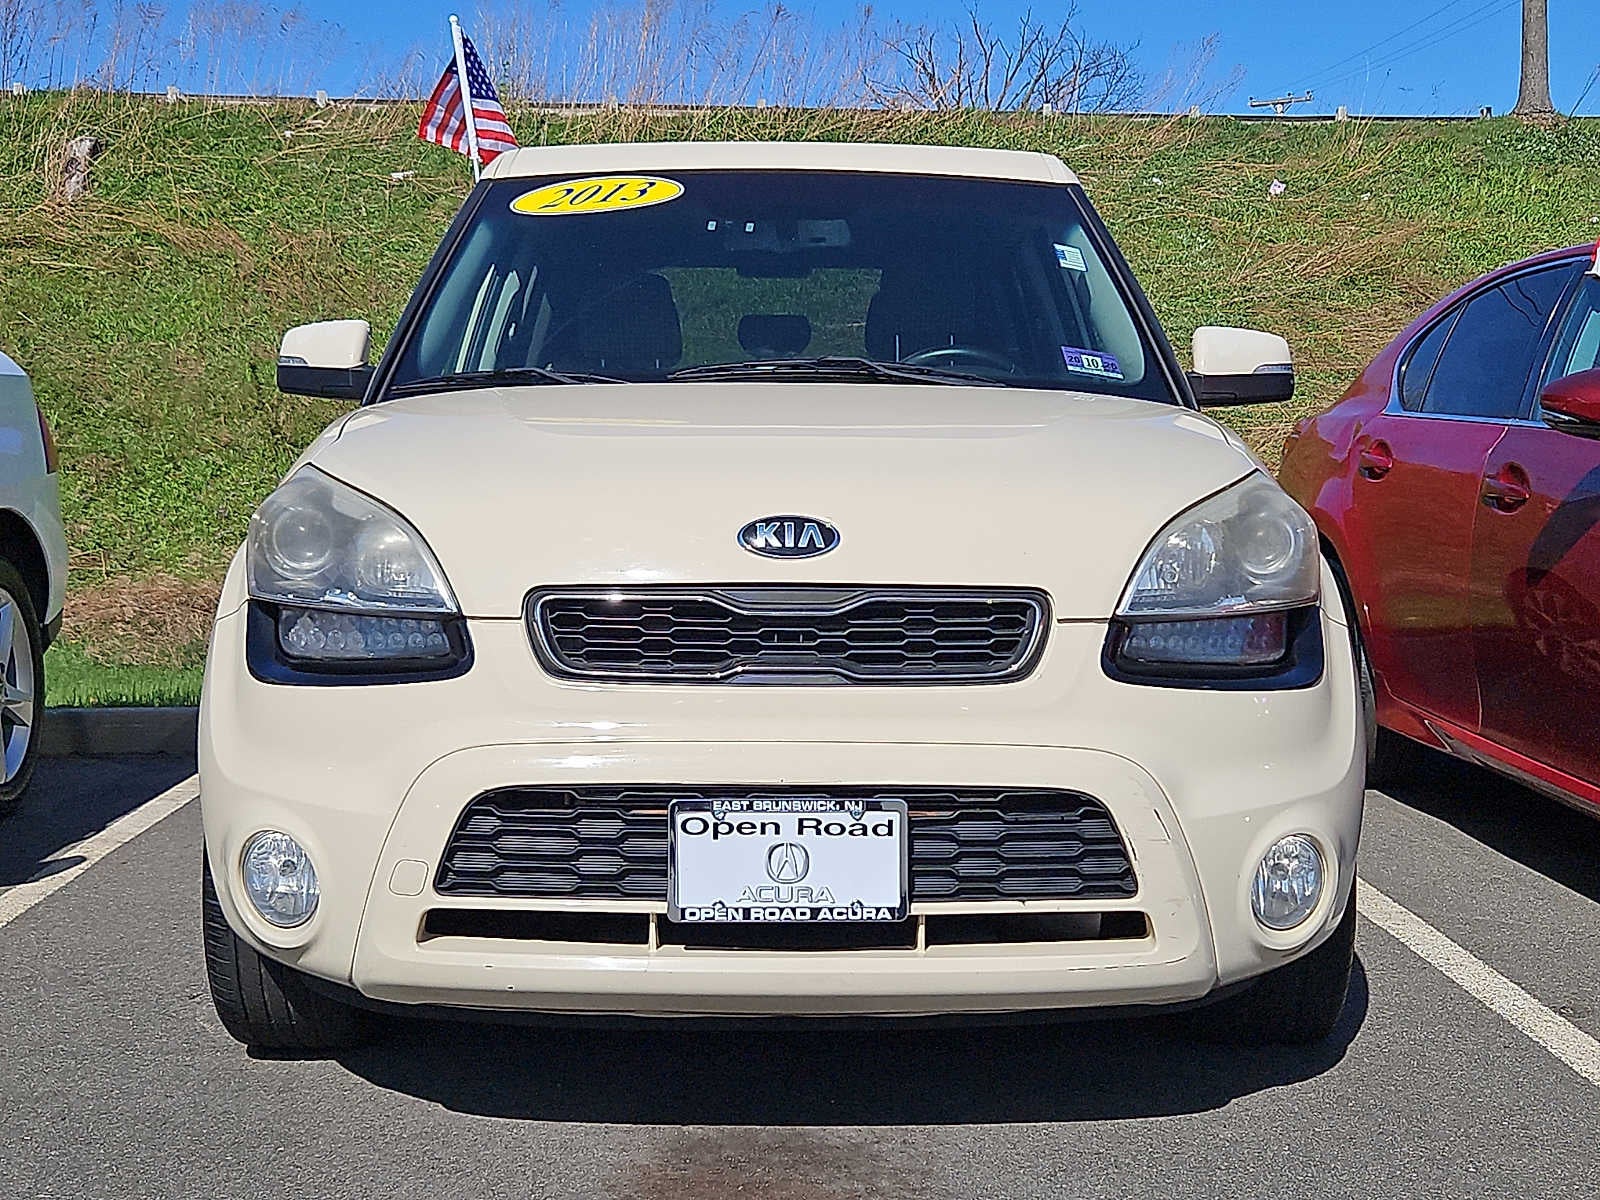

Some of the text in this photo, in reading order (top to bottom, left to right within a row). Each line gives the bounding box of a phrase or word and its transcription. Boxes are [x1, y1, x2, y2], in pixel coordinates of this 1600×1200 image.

[538, 182, 656, 209] 2013
[1085, 357, 1099, 369] 10
[755, 522, 825, 548] KIA
[713, 800, 863, 811] EAST BRUNSWICK, NJ
[680, 817, 894, 840] Open Road
[736, 886, 835, 904] ACURA
[684, 907, 892, 920] OPEN ROAD ACURA
